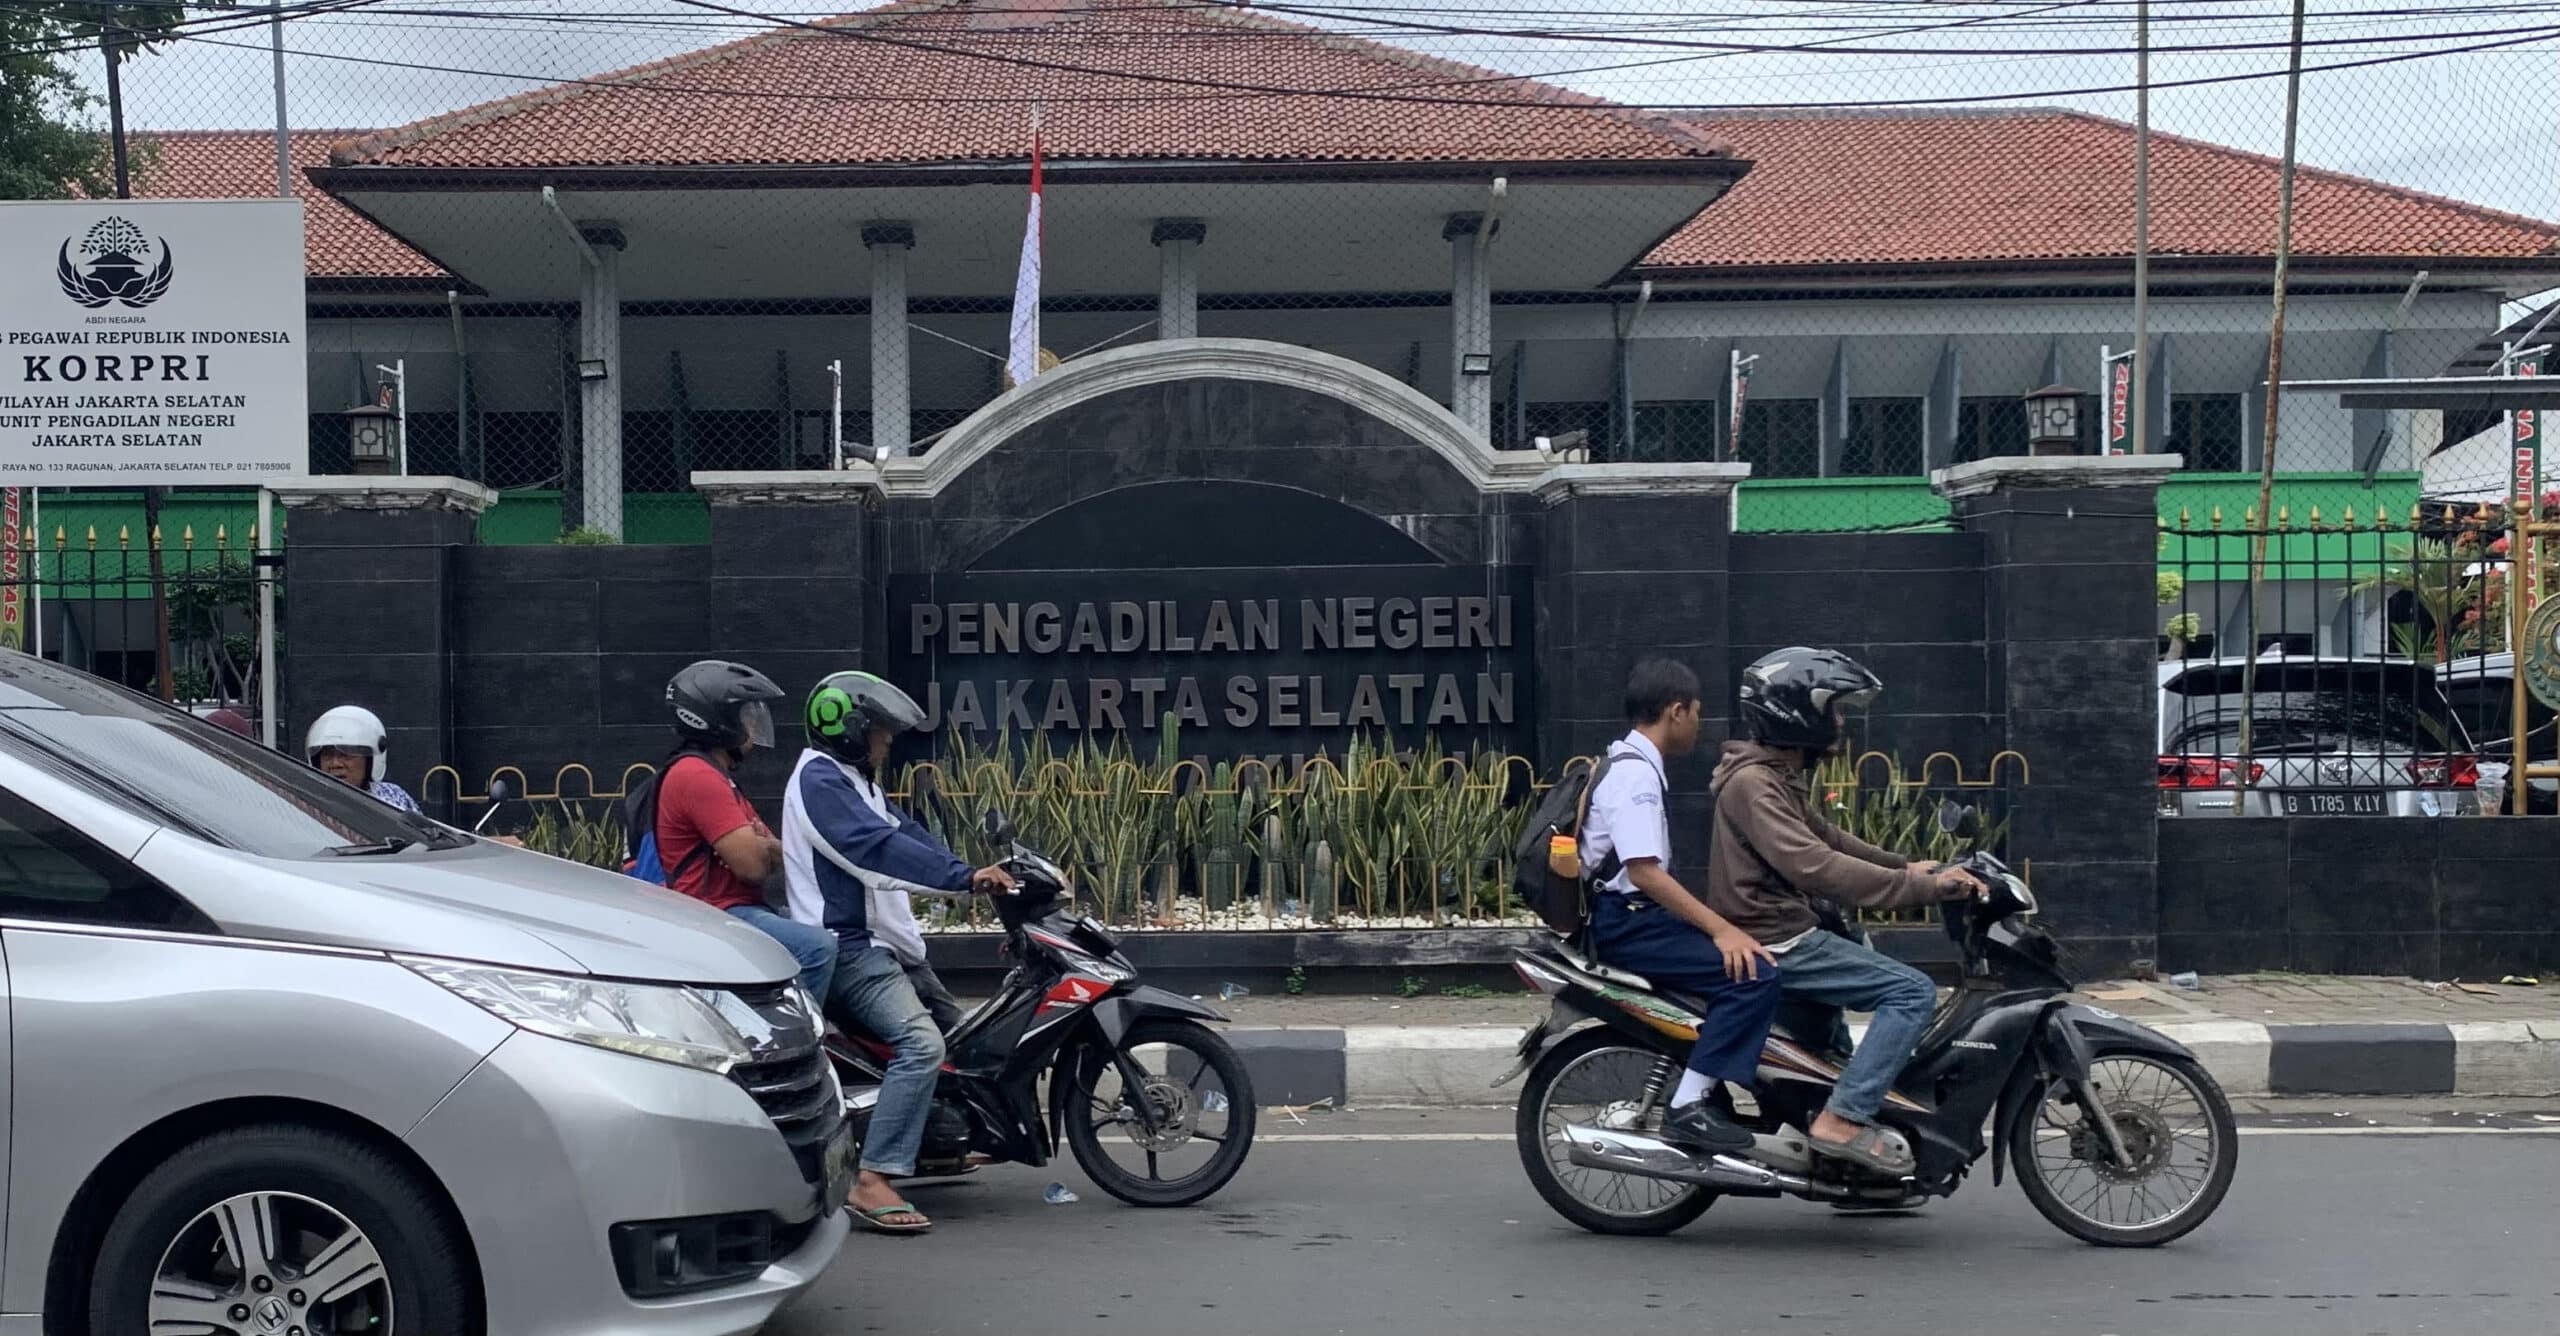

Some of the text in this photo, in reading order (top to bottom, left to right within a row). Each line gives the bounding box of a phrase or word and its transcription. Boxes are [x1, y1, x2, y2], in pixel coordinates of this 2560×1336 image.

[84, 315, 147, 324] ABDI NEGARA
[8, 332, 90, 345] PEGAWAI
[96, 332, 187, 345] REPUBLIK
[191, 331, 291, 344] INDONESIA
[23, 355, 210, 382] KORPRI
[75, 395, 160, 408] JAKARTA
[165, 395, 247, 408] SELATAN
[2112, 362, 2129, 442] ZONA
[2517, 362, 2537, 442] ZNA
[0, 414, 236, 428] UNIT PENGADILAN NEGERI
[32, 434, 203, 448] JAKARTA SELATAN
[2, 463, 28, 472] RAYA
[118, 463, 162, 472] JAKARTA
[164, 462, 207, 472] SELATAN
[236, 462, 252, 472] 021
[910, 596, 1512, 655] PENGADILAN NEGERI
[916, 672, 1514, 733] JAKARTA SELATAN
[2288, 796, 2298, 813] B
[2310, 795, 2345, 813] 1785
